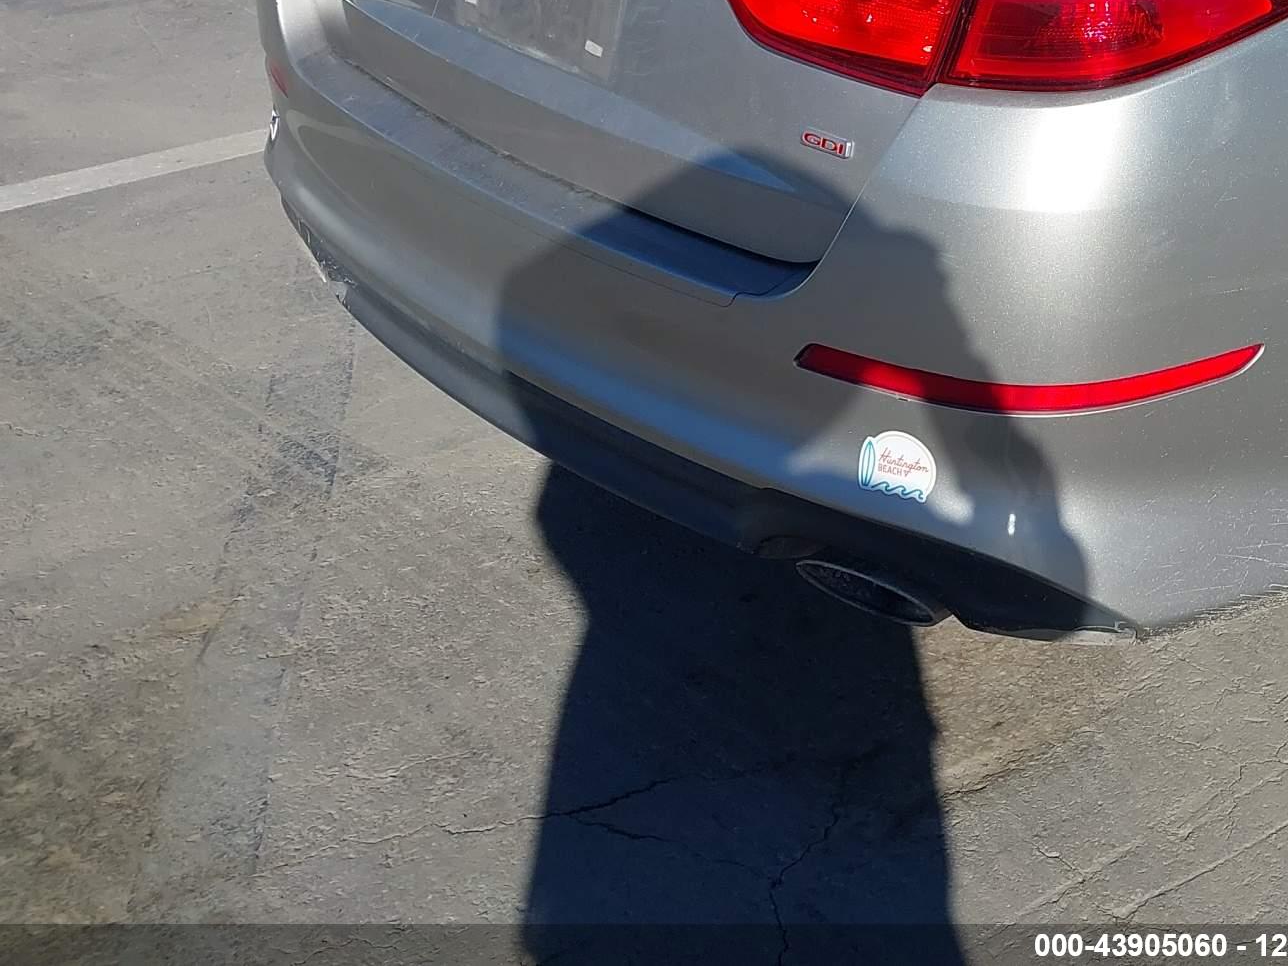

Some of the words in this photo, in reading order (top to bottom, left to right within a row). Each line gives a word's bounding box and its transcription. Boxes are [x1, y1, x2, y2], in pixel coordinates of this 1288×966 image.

[802, 132, 846, 156] GDI
[878, 463, 902, 476] BEACH
[879, 447, 929, 473] Huntington
